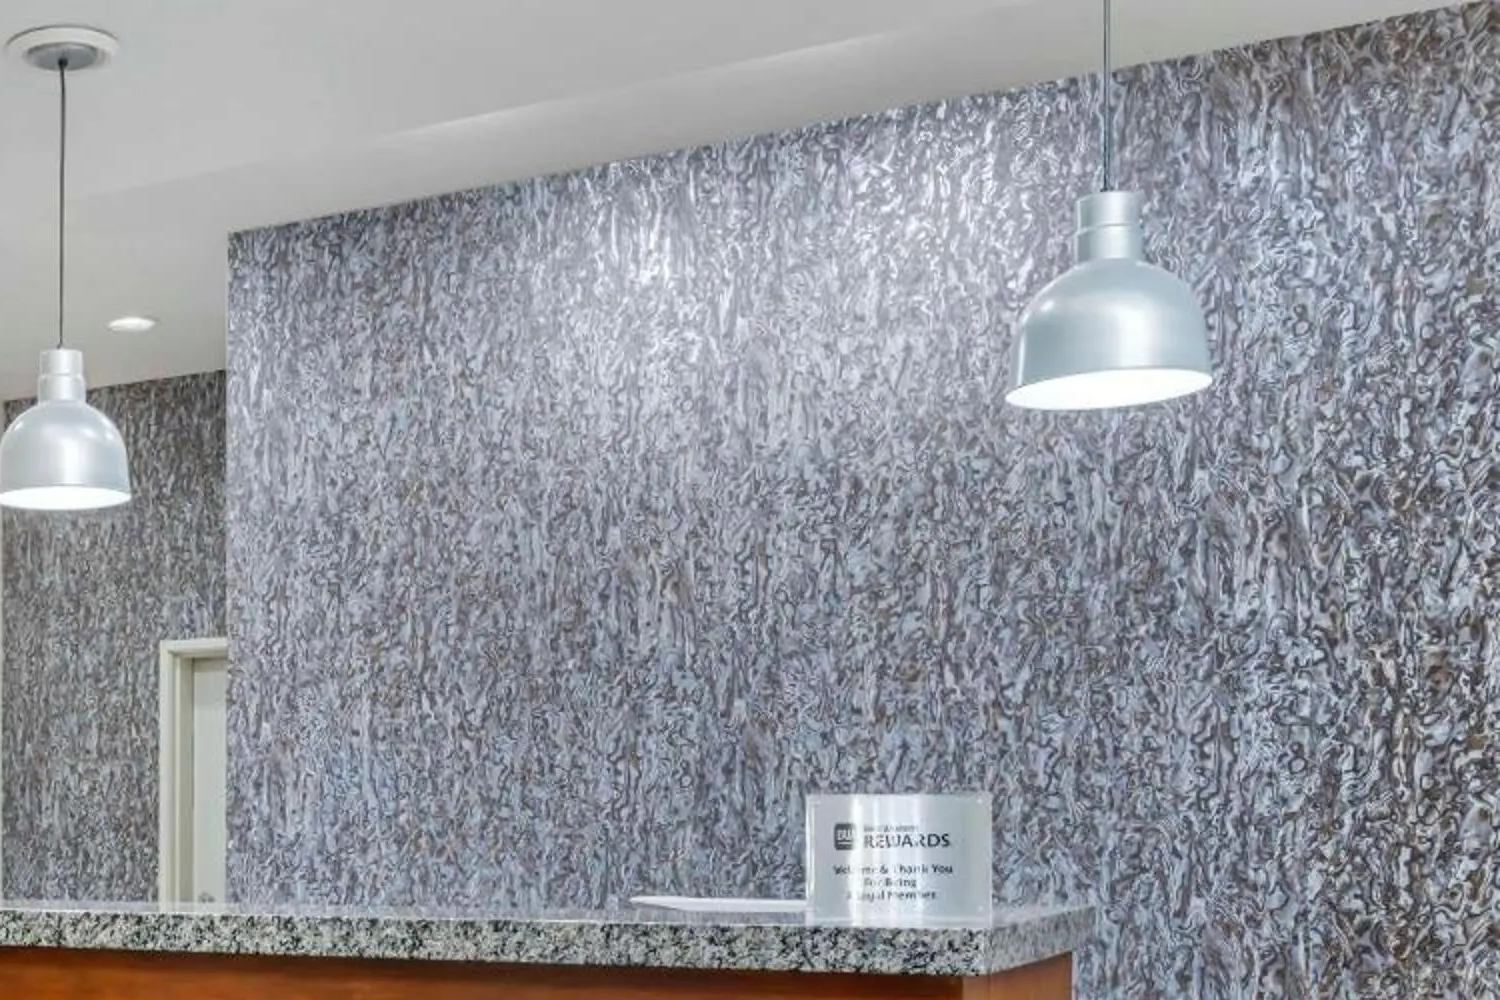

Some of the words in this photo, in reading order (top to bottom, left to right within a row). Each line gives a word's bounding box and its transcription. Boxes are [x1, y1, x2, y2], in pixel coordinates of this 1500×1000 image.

[863, 833, 951, 849] REWARDS
[833, 864, 877, 875] Welme
[892, 864, 929, 875] hank
[931, 865, 953, 874] You
